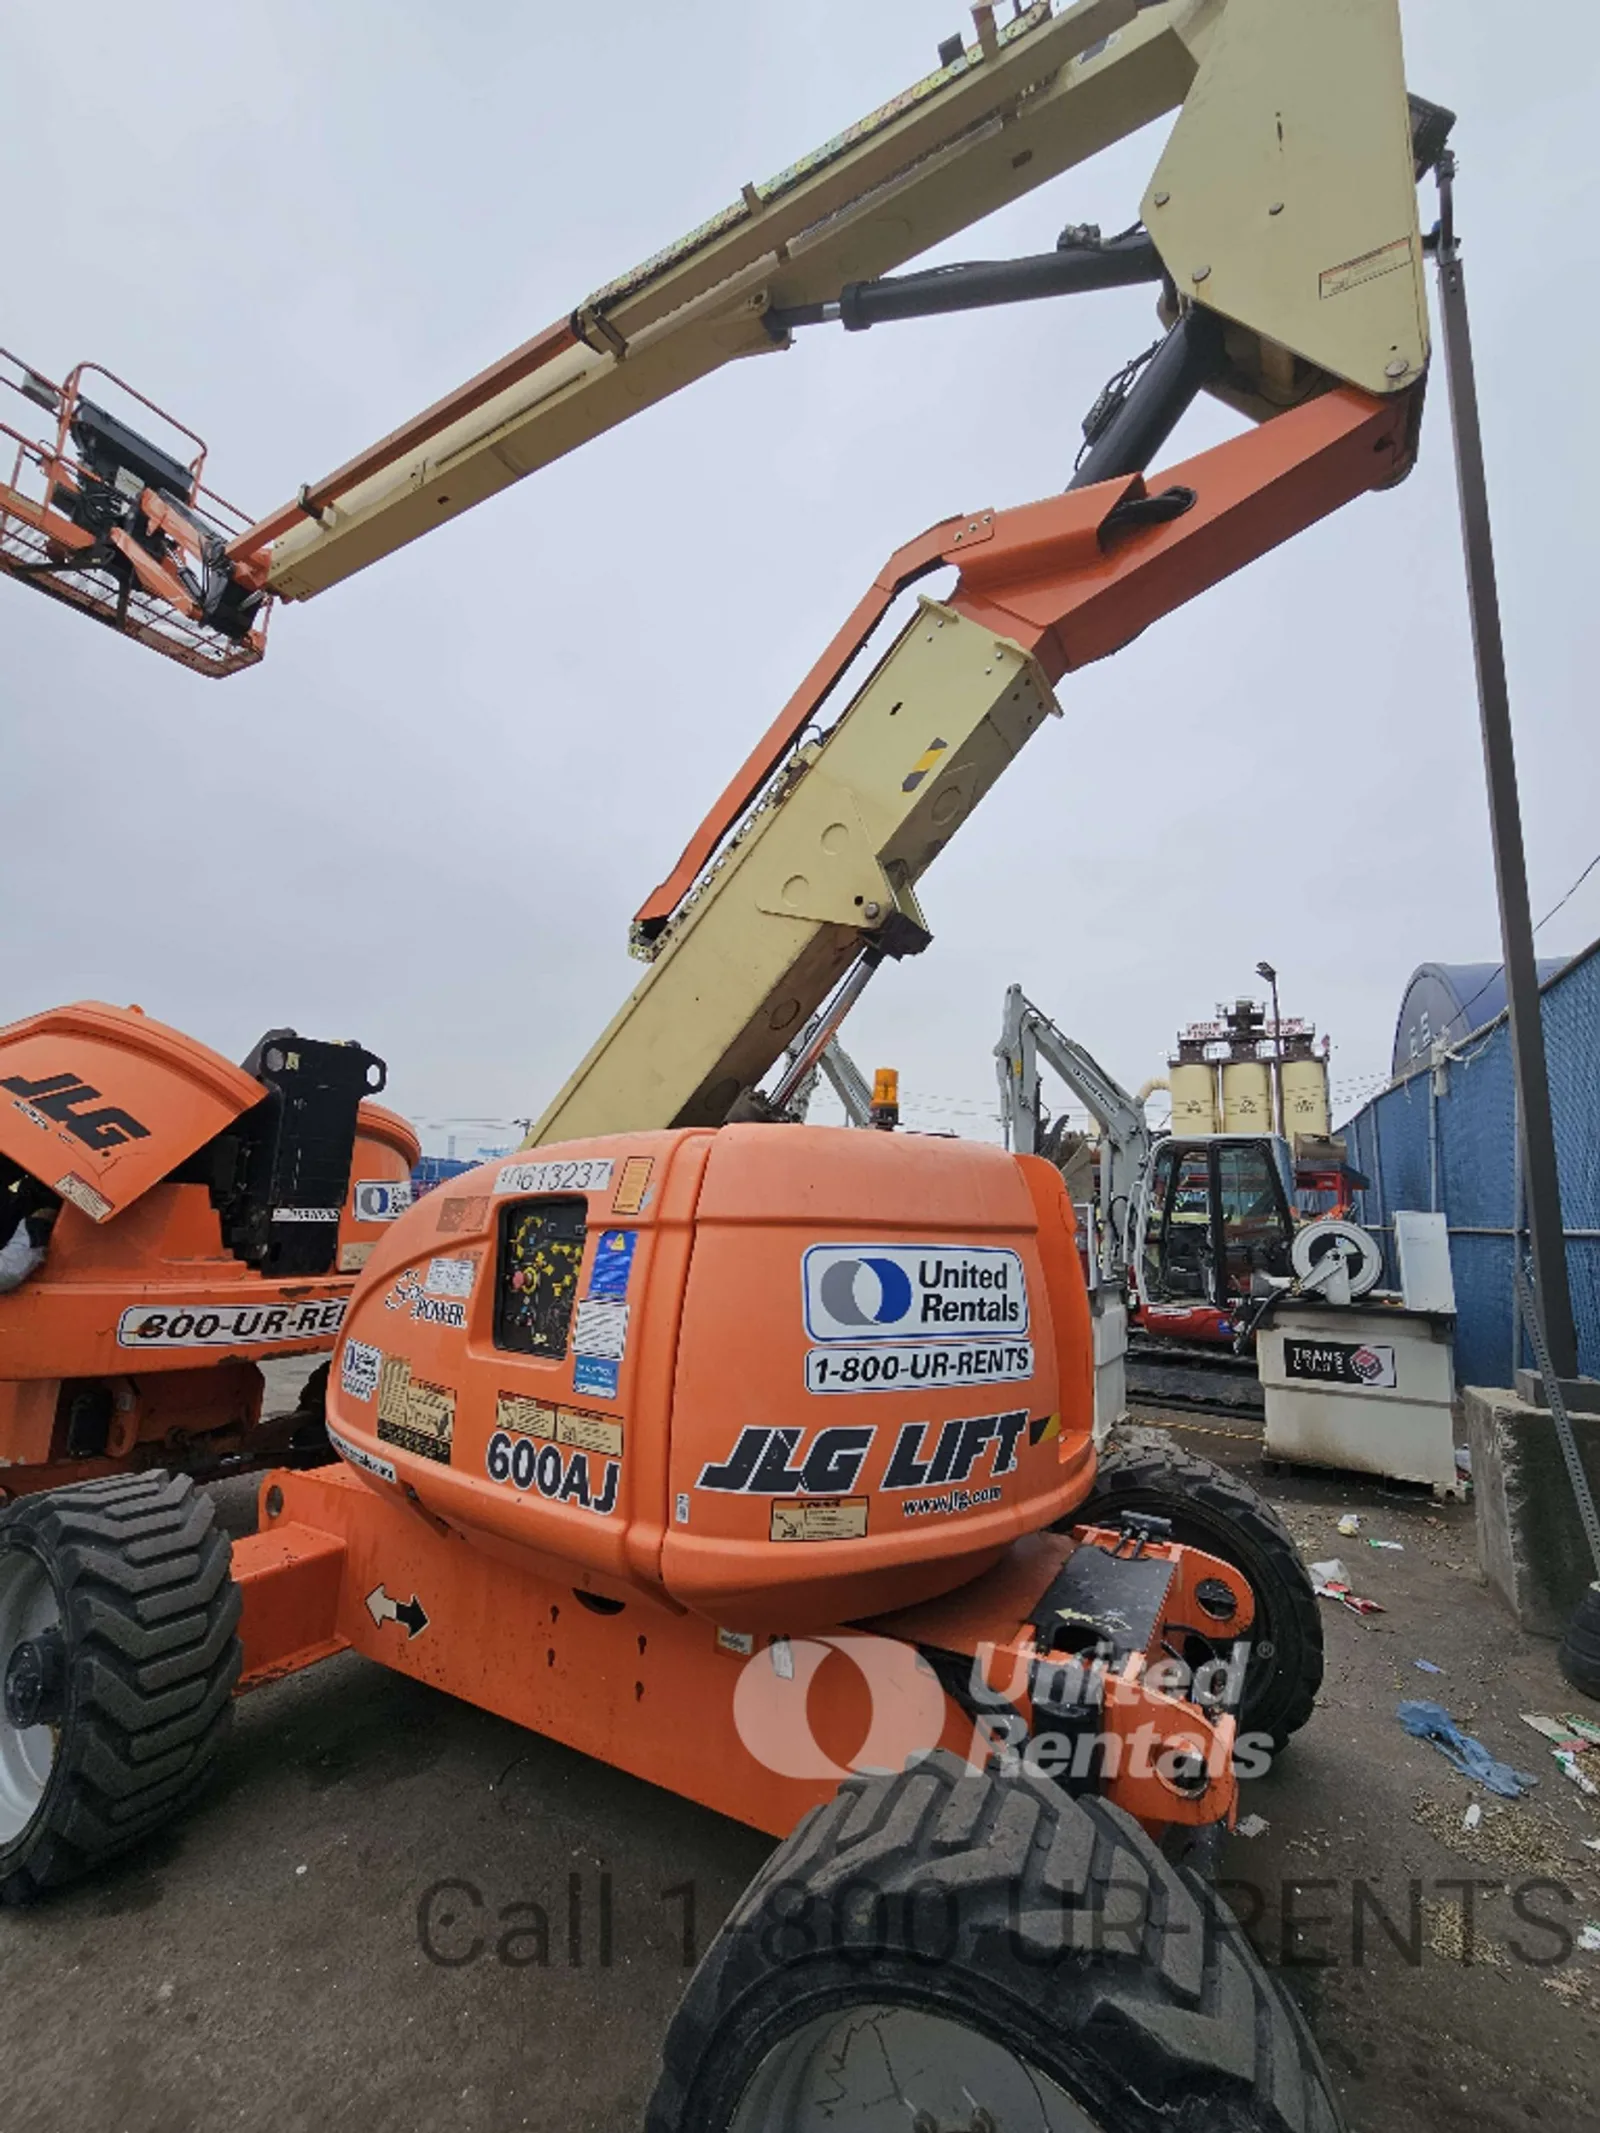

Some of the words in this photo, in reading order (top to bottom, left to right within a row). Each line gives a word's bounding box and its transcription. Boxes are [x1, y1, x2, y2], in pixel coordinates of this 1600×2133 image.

[0, 1073, 152, 1151] JLG
[918, 1260, 1008, 1289] United
[920, 1294, 1019, 1324] Rentals
[814, 1347, 1029, 1384] 1-800-UR-RENTS
[1292, 1347, 1345, 1365] TRANS
[695, 1425, 877, 1495] JLG
[879, 1409, 1030, 1491] LIFT
[487, 1431, 621, 1514] 600AJ
[902, 1486, 1001, 1516] www.jlg.com
